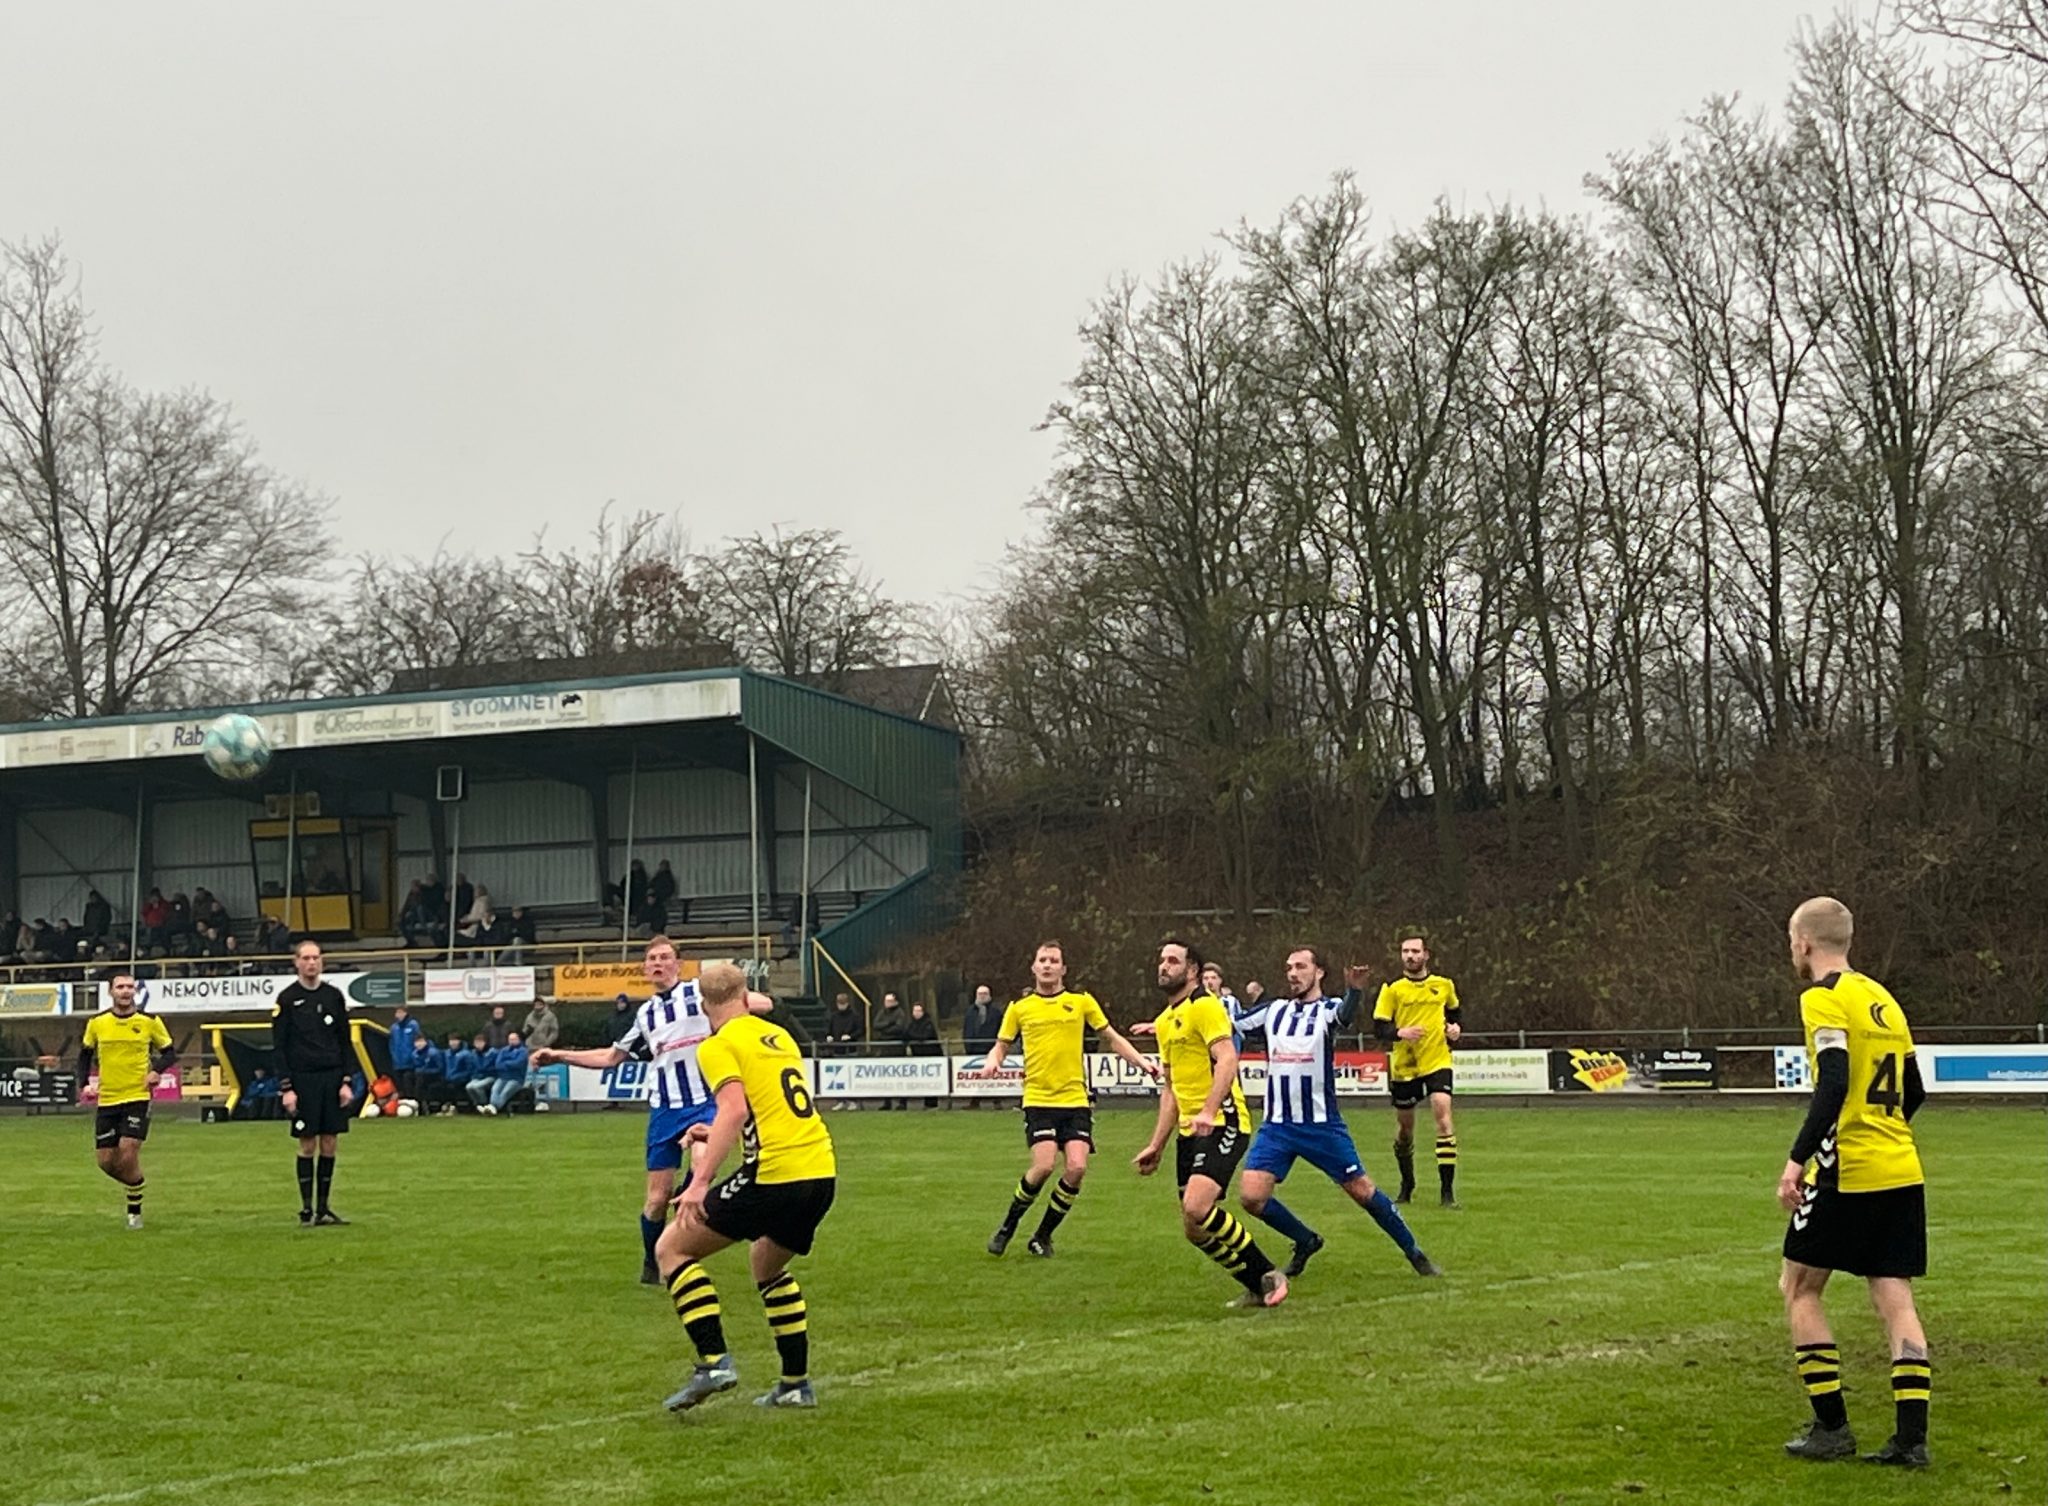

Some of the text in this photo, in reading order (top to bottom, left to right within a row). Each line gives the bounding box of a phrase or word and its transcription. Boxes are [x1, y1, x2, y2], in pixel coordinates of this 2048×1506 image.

[451, 695, 555, 718] STOOMNET
[172, 725, 205, 748] Rab
[561, 965, 588, 980] Club
[590, 968, 609, 979] van
[162, 979, 274, 998] NEMOVEILING
[854, 1062, 943, 1079] ZWIKKER ICT
[781, 1067, 814, 1118] 6
[1866, 1052, 1901, 1117] 4
